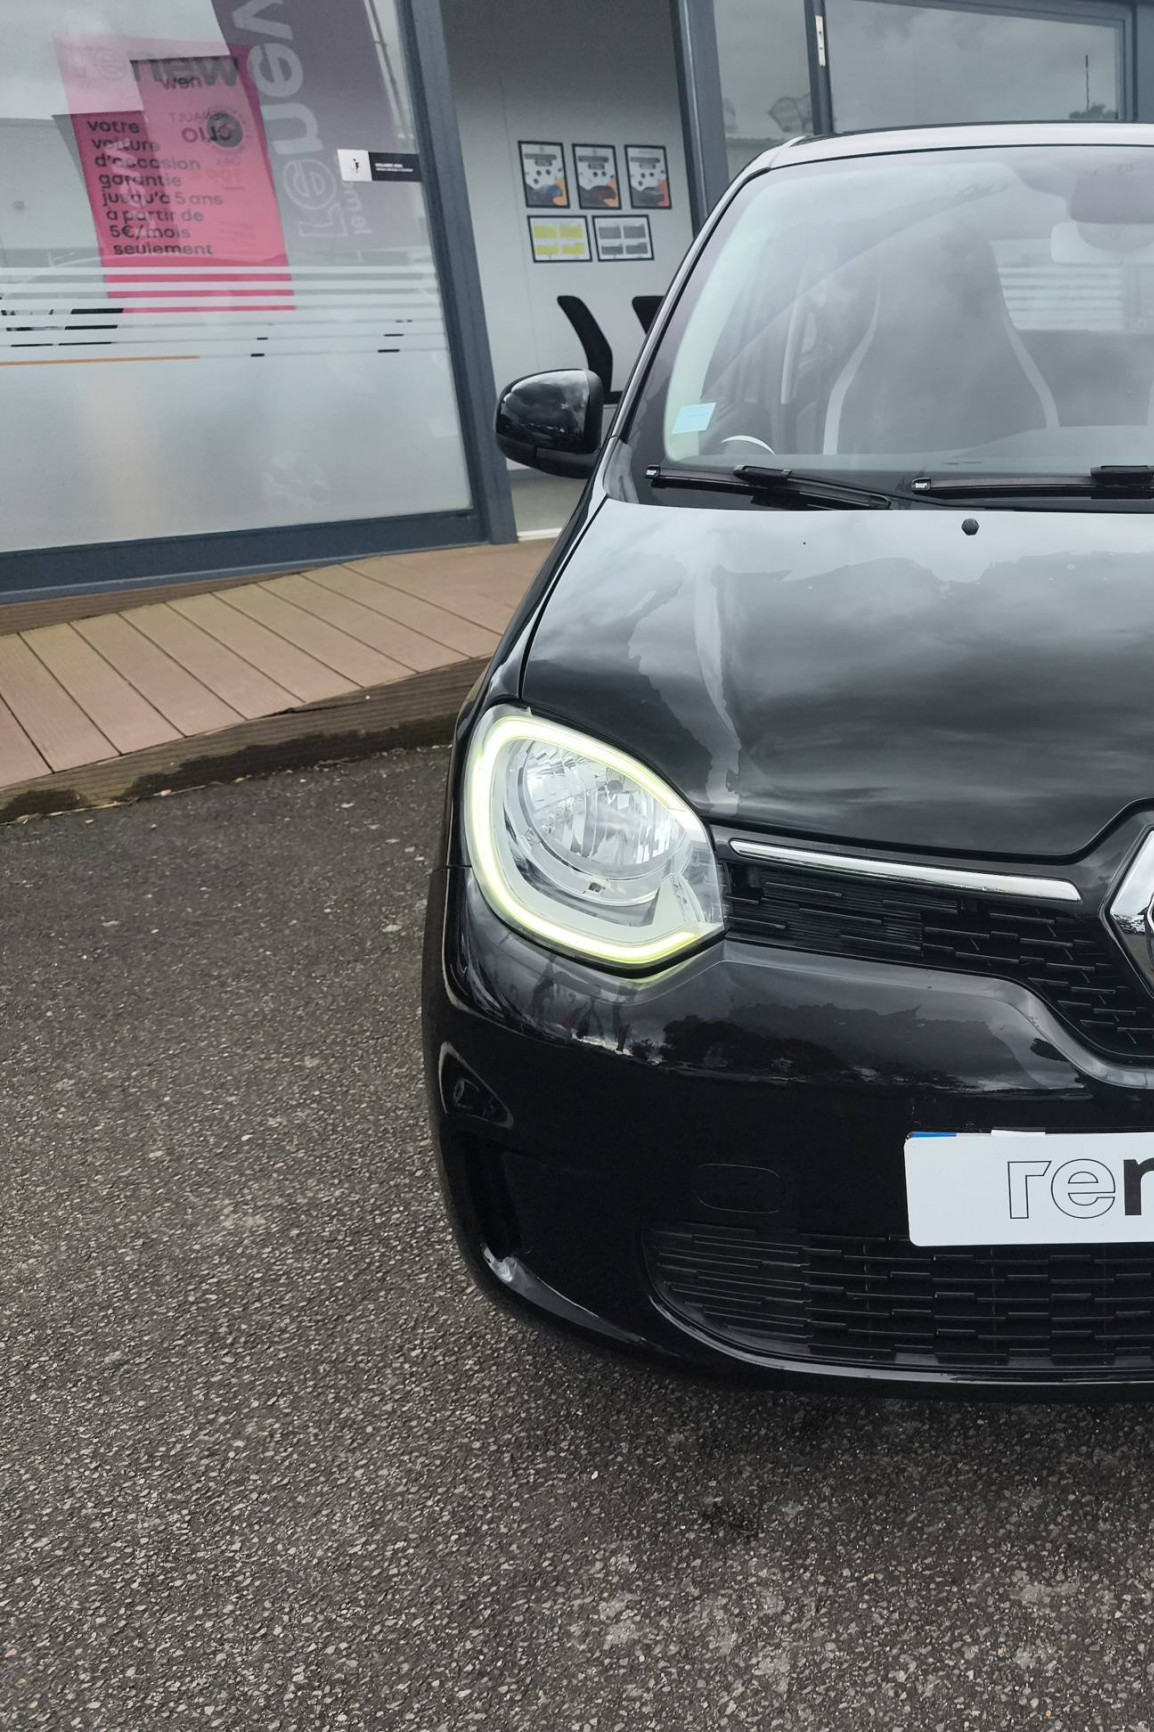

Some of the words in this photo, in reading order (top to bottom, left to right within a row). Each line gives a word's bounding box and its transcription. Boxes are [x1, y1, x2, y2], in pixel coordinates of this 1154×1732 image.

[87, 120, 140, 134] votre
[99, 173, 182, 188] garantie
[175, 192, 186, 204] 5
[189, 195, 223, 206] ans
[123, 209, 175, 224] partir
[181, 209, 204, 222] de
[110, 225, 191, 240] 5€/mois
[113, 244, 213, 256] seulement
